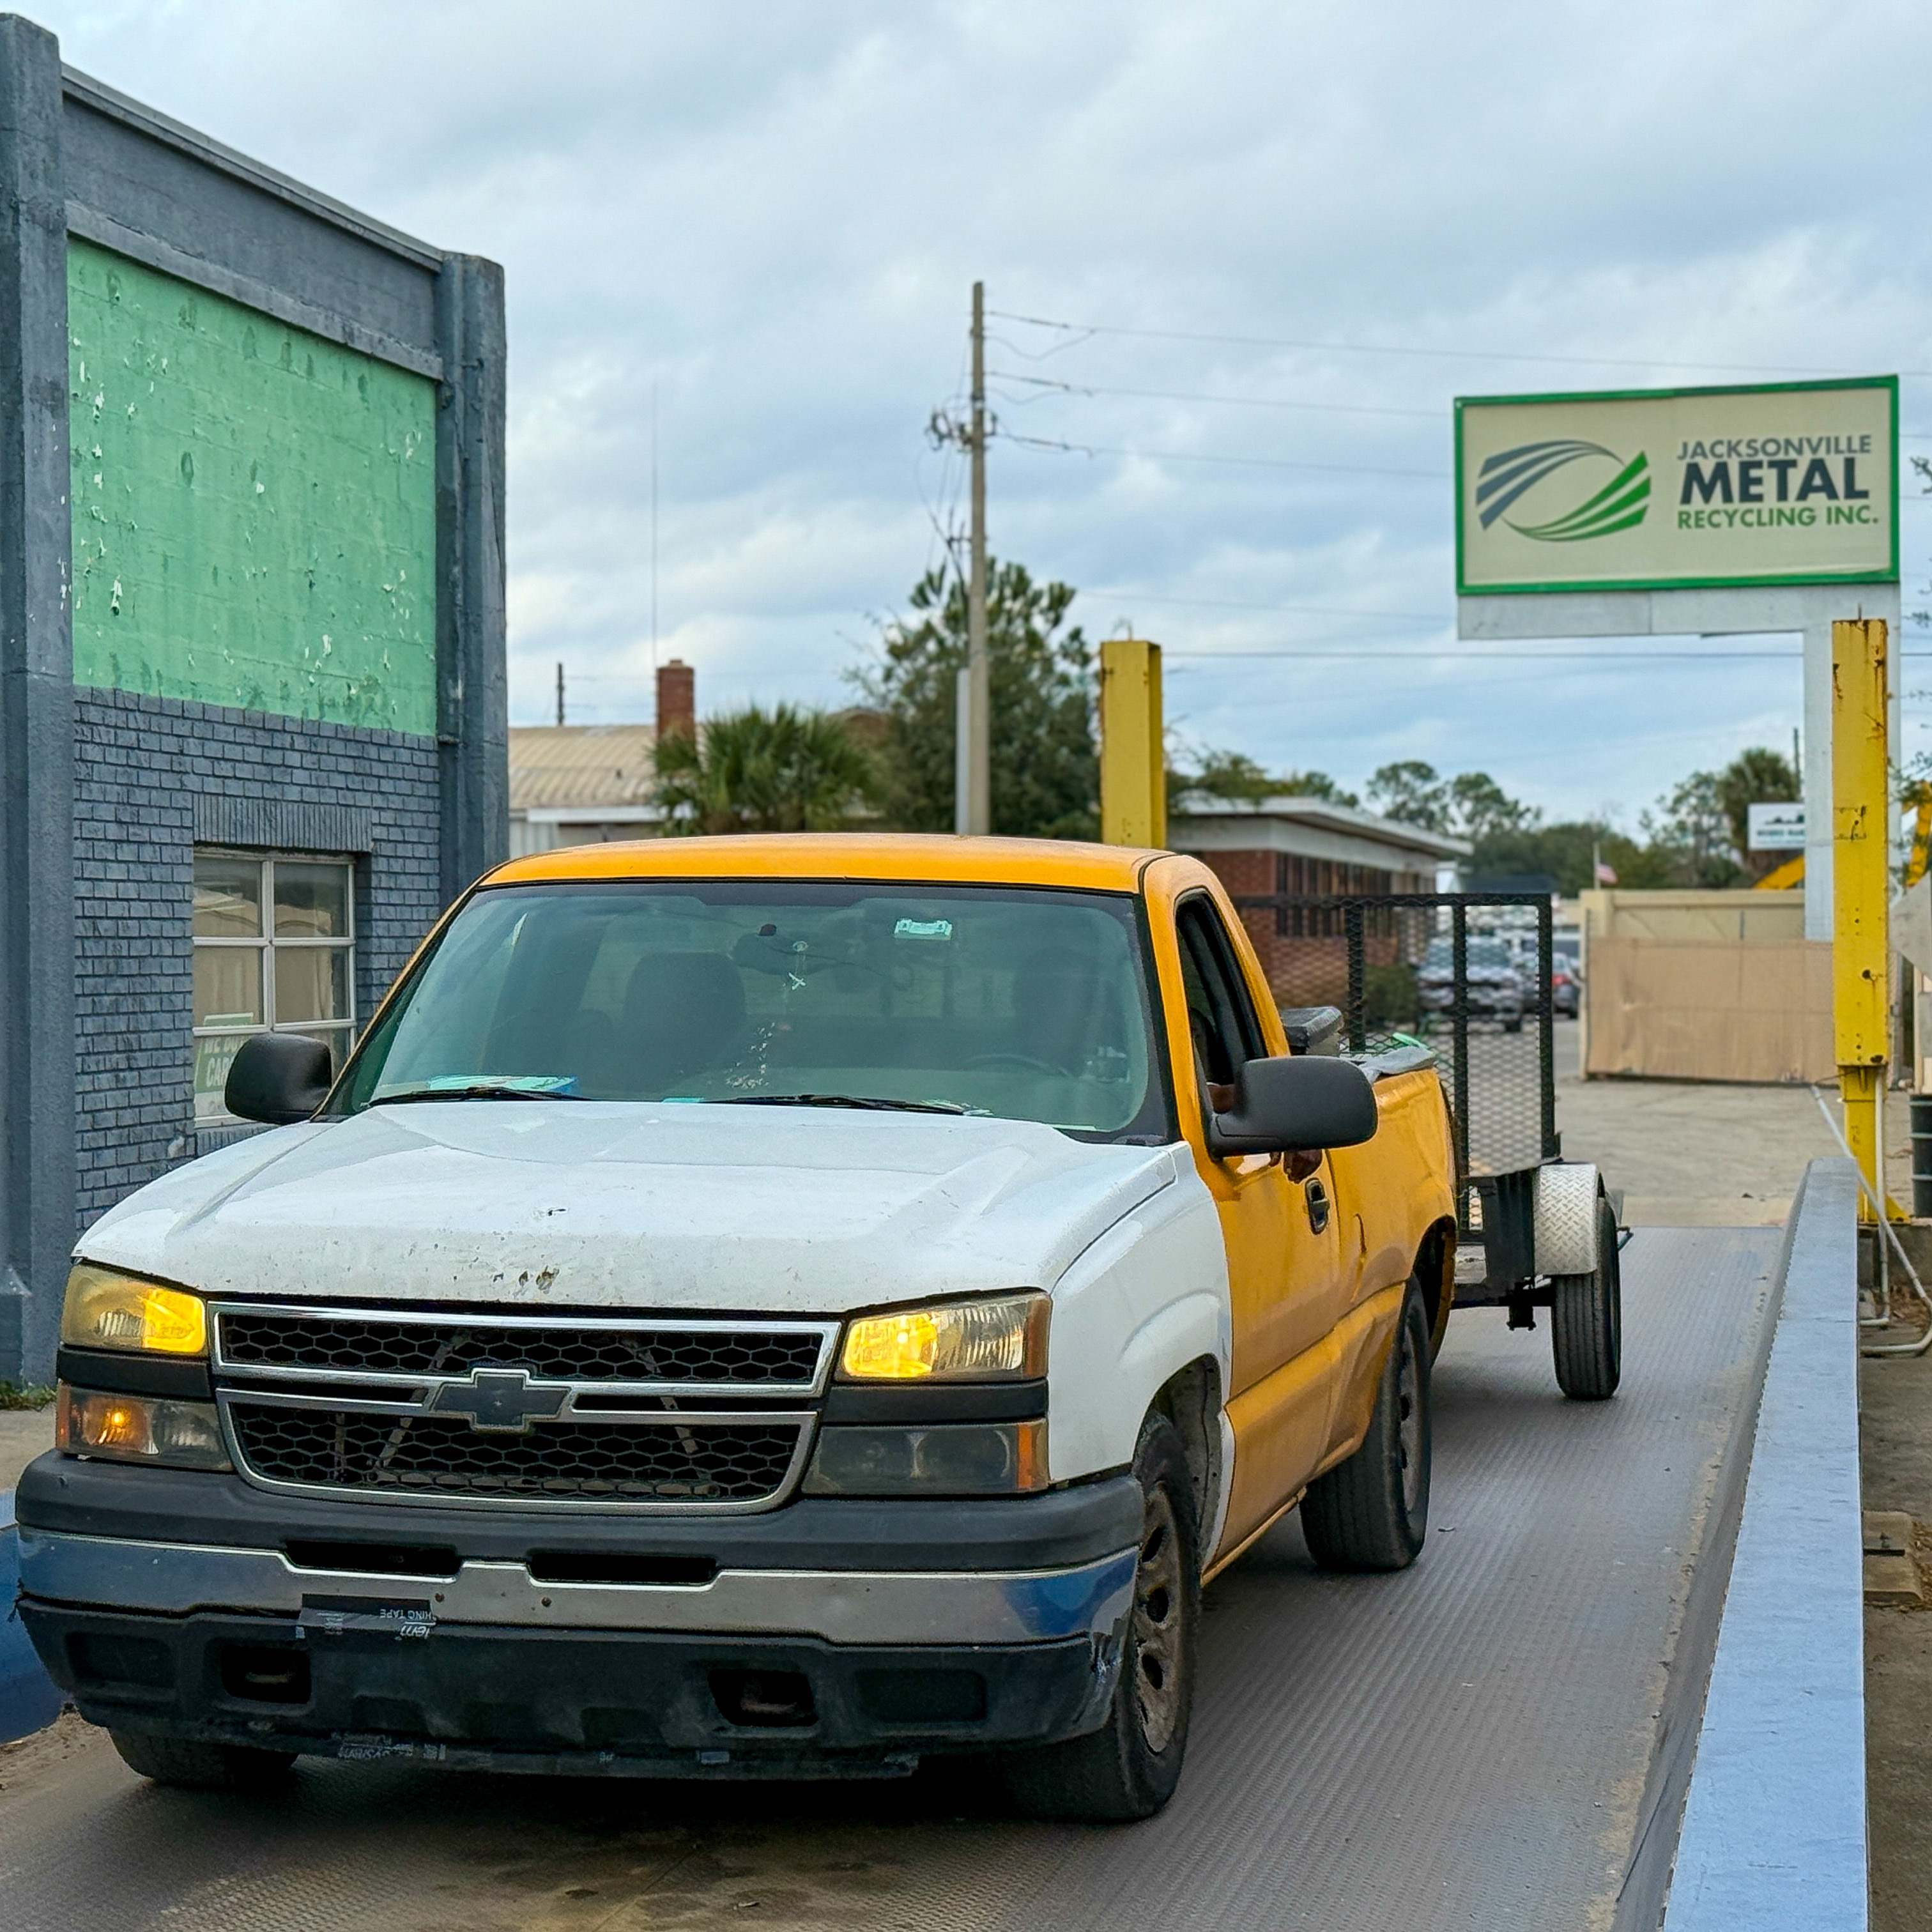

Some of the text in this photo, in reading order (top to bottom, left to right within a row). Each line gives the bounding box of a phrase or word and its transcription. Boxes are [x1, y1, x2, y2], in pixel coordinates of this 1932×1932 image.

[1677, 434, 1872, 460] JACKSONVILLE
[1680, 457, 1869, 505] METAL
[1677, 505, 1878, 530] RECYCLING INC.
[379, 1608, 406, 1620] TAPE
